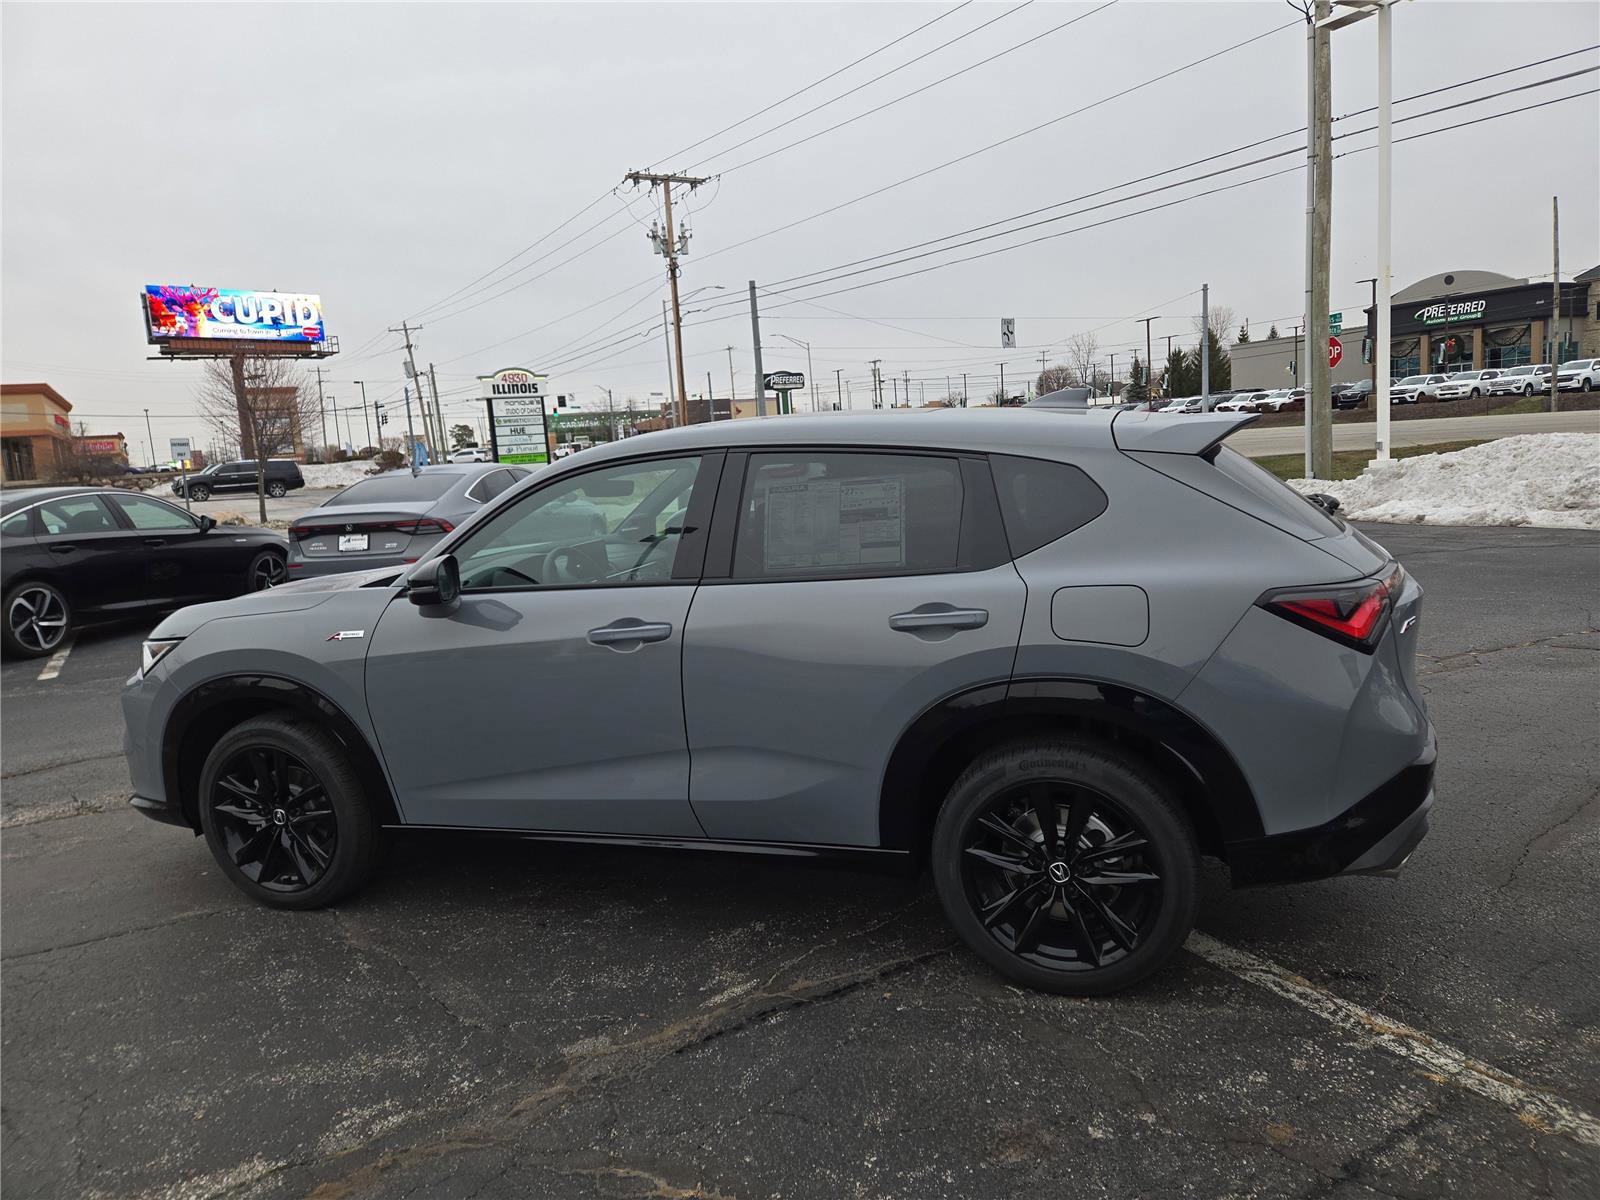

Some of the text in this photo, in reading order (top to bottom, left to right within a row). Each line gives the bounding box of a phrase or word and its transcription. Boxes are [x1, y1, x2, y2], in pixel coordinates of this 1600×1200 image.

[210, 296, 319, 326] CUPID
[1423, 300, 1486, 320] PREFERRED
[1427, 312, 1477, 324] Automtive Group
[1329, 346, 1341, 359] OP
[501, 373, 528, 383] 4930
[770, 375, 804, 386] PREFERRED
[492, 383, 539, 395] ILLINOIS
[509, 427, 527, 435] HUE
